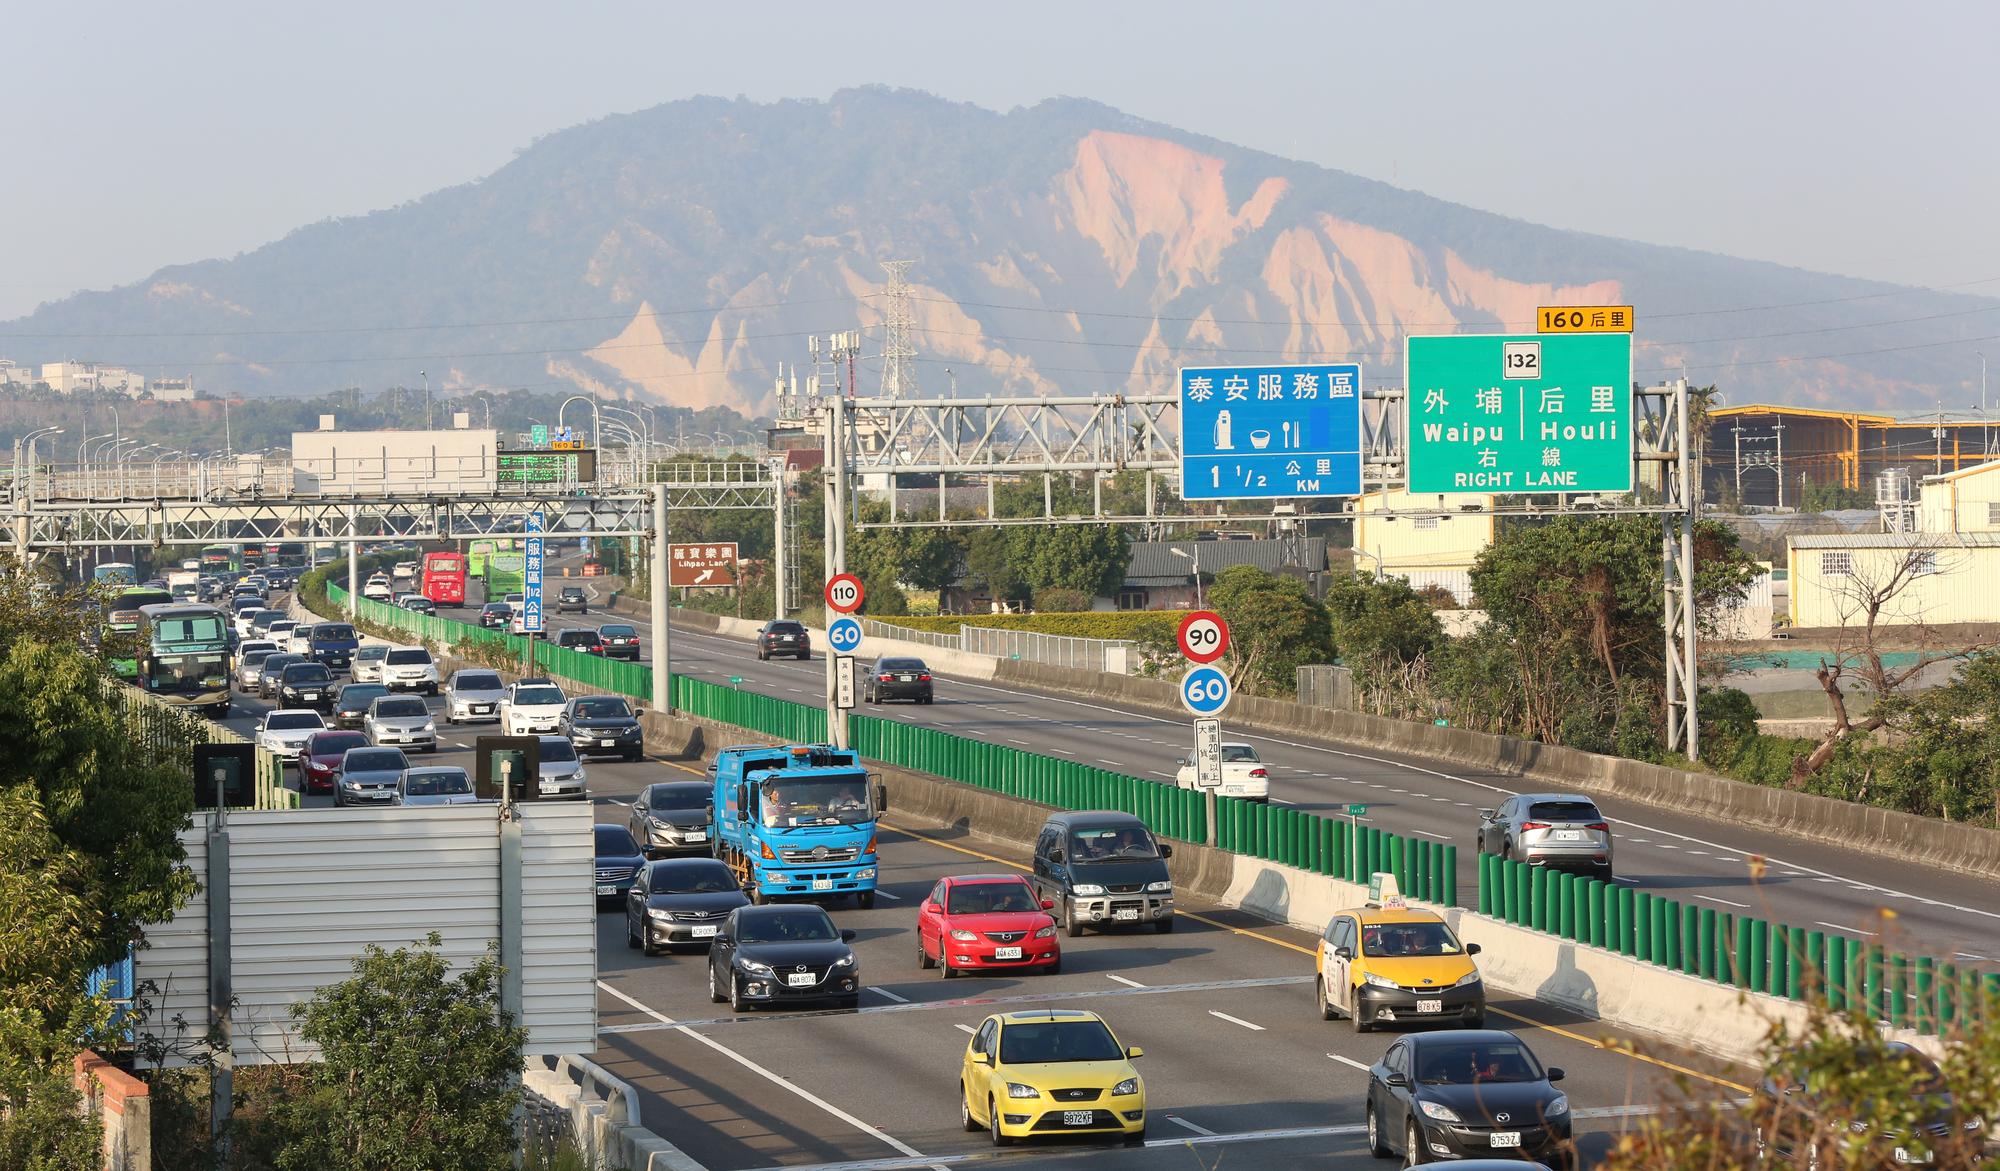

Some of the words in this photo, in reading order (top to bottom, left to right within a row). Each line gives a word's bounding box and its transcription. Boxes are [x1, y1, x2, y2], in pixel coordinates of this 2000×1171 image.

[1545, 312, 1583, 327] 160
[1591, 311, 1626, 328] 后里
[1508, 354, 1537, 369] 132
[1188, 373, 1354, 402] 泰安服務區
[1424, 387, 1502, 414] 外埔
[1539, 386, 1616, 414] 后里
[1424, 423, 1503, 445] Waipu
[1541, 420, 1616, 440] Houli
[1286, 459, 1332, 476] 公里
[1296, 480, 1320, 492] KM
[1455, 472, 1513, 487] RIGHT
[1526, 472, 1578, 486] LANE
[833, 587, 855, 600] 110
[831, 626, 859, 644] 60
[1189, 629, 1217, 647] 90
[1188, 678, 1224, 702] 60
